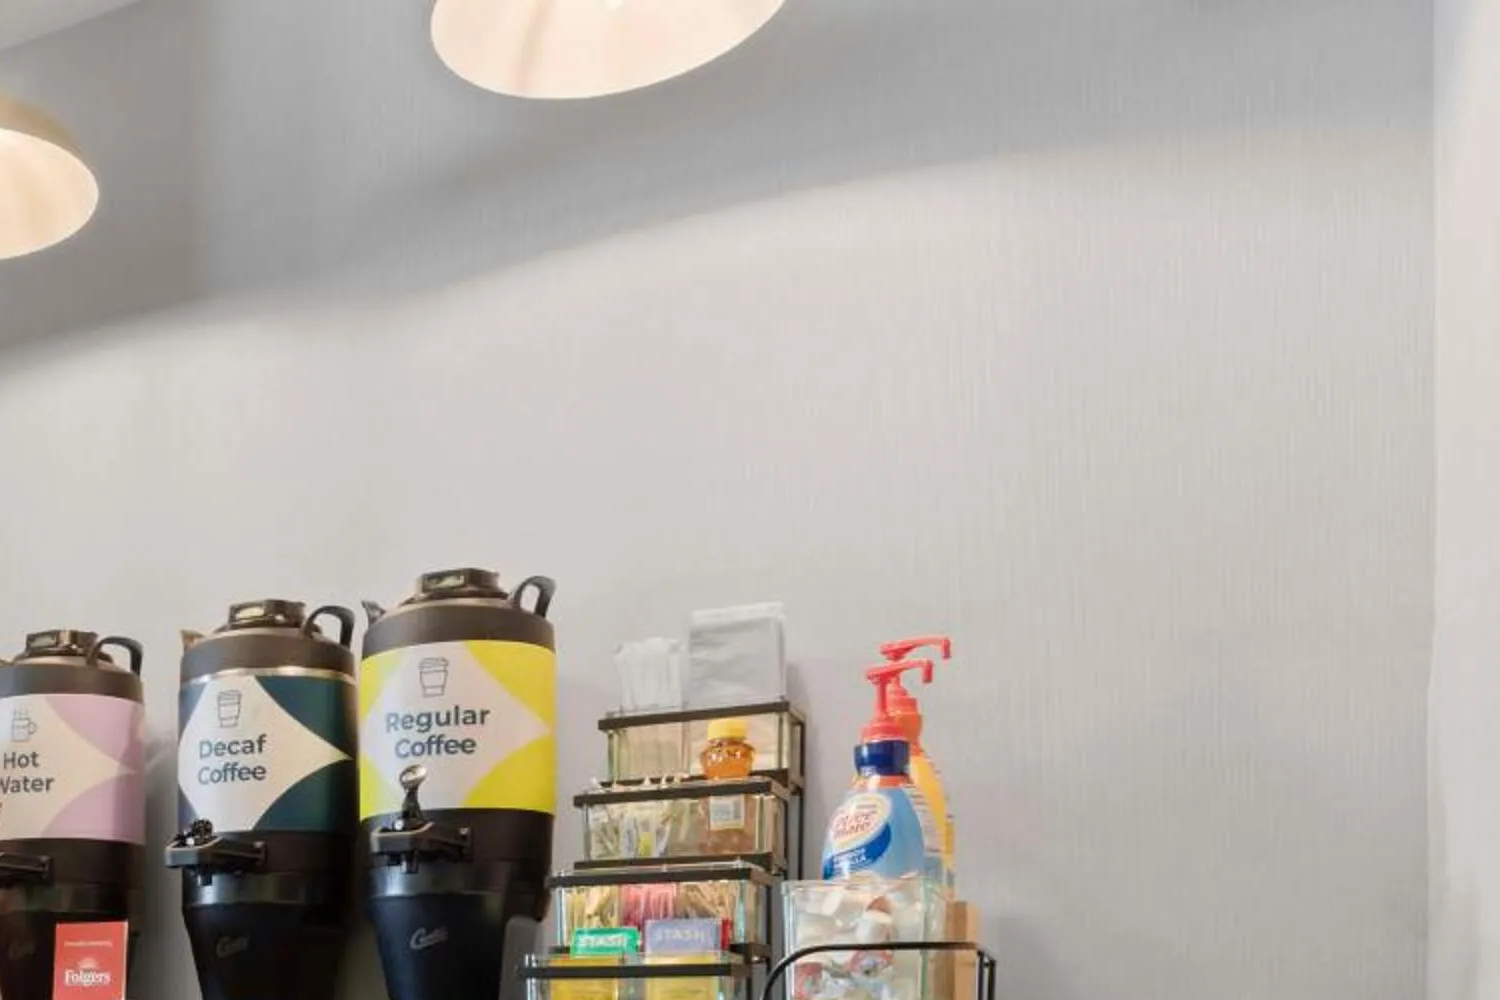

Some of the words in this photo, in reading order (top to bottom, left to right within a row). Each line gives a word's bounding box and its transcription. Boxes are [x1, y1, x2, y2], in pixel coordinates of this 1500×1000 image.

[386, 705, 490, 733] Regular
[199, 733, 267, 758] Decaf
[395, 734, 477, 758] Coffee
[3, 751, 40, 769] Hot
[198, 762, 267, 785] Coffee
